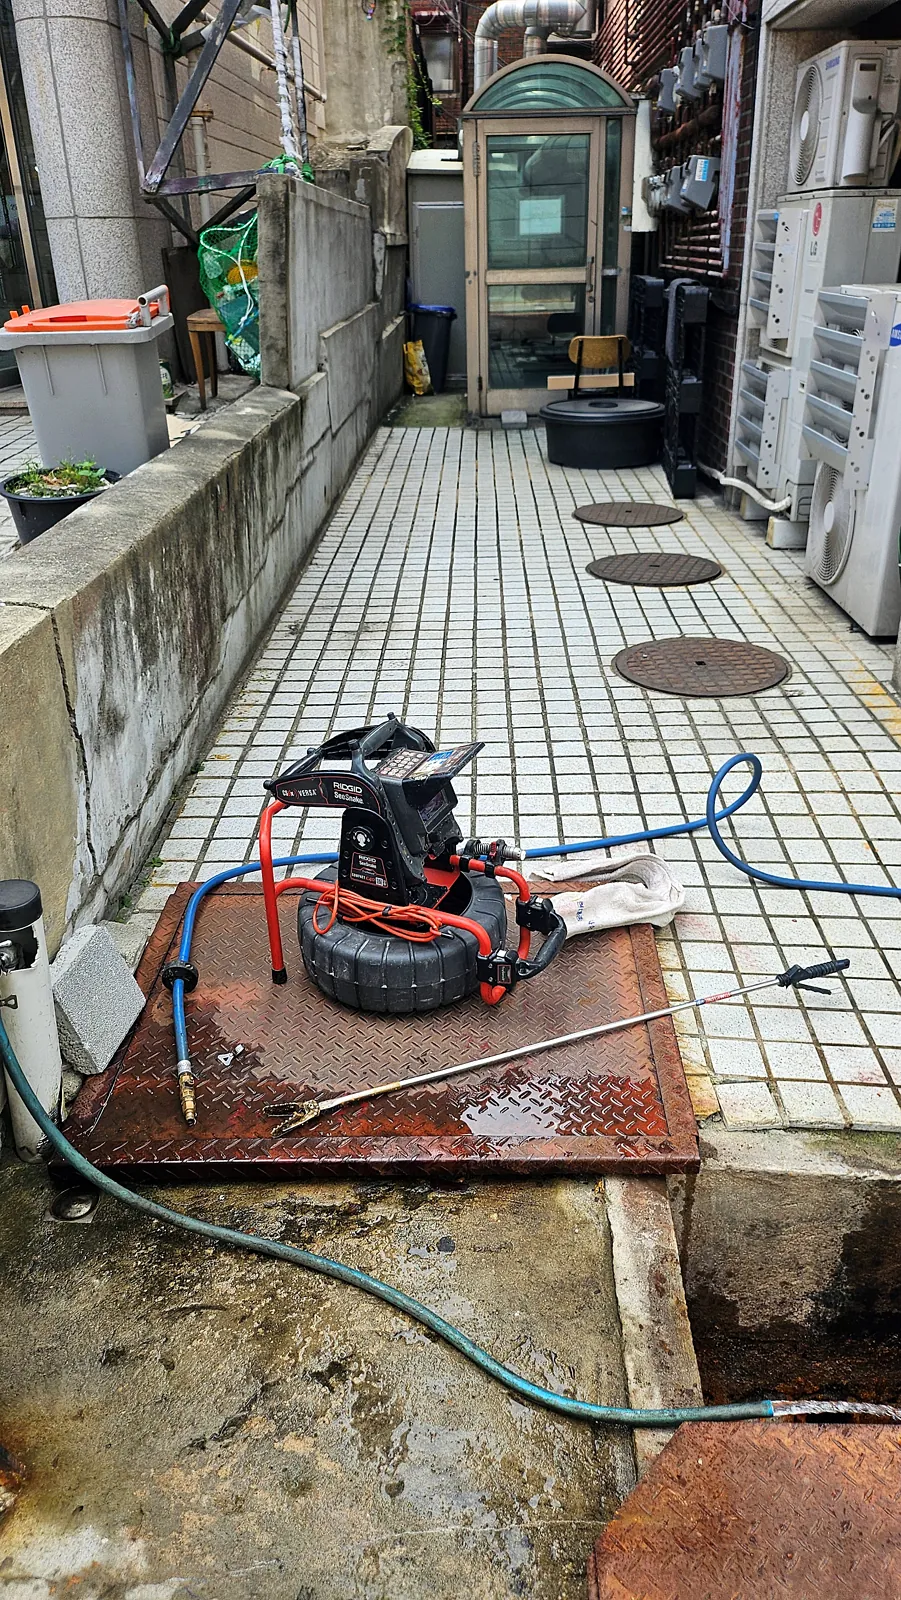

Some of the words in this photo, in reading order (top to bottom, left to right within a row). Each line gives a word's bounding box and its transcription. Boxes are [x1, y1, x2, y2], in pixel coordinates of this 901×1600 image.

[810, 241, 818, 256] LG
[298, 788, 317, 797] VERSA
[333, 781, 363, 794] RIDGID
